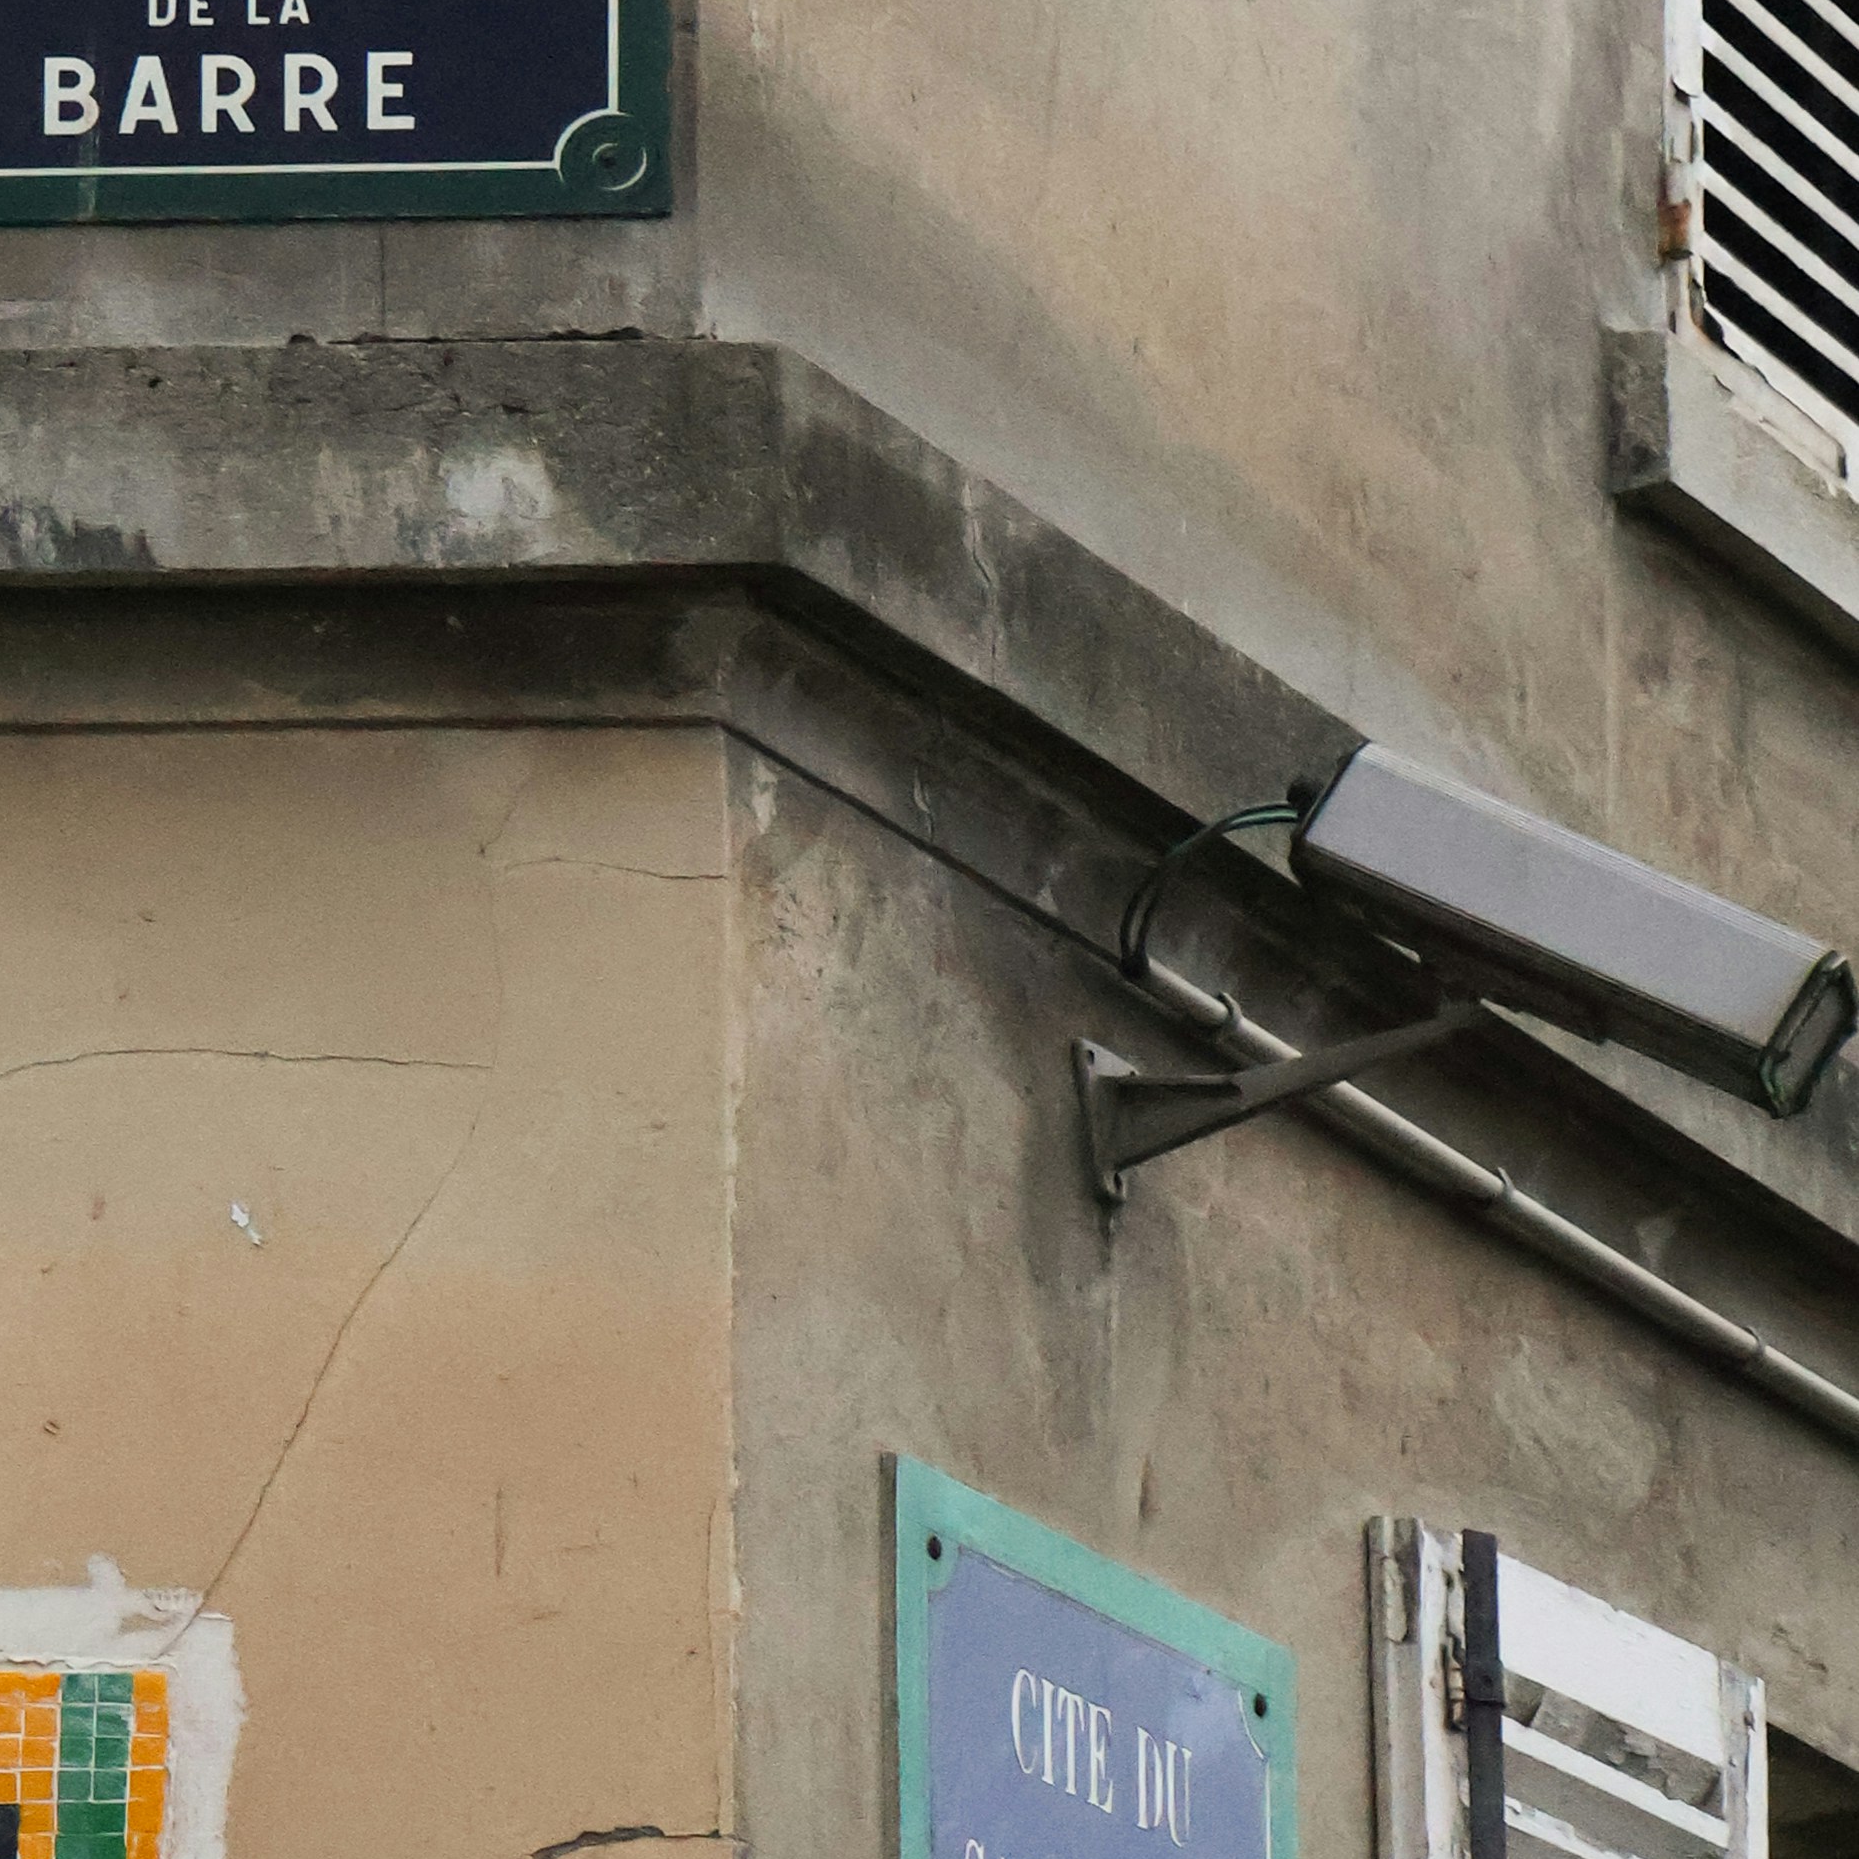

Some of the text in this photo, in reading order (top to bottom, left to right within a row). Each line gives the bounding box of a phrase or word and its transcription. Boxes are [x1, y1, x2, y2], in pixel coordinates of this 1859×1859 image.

[43, 51, 415, 136] BARRE
[1010, 1668, 1194, 1847] CITE DU
